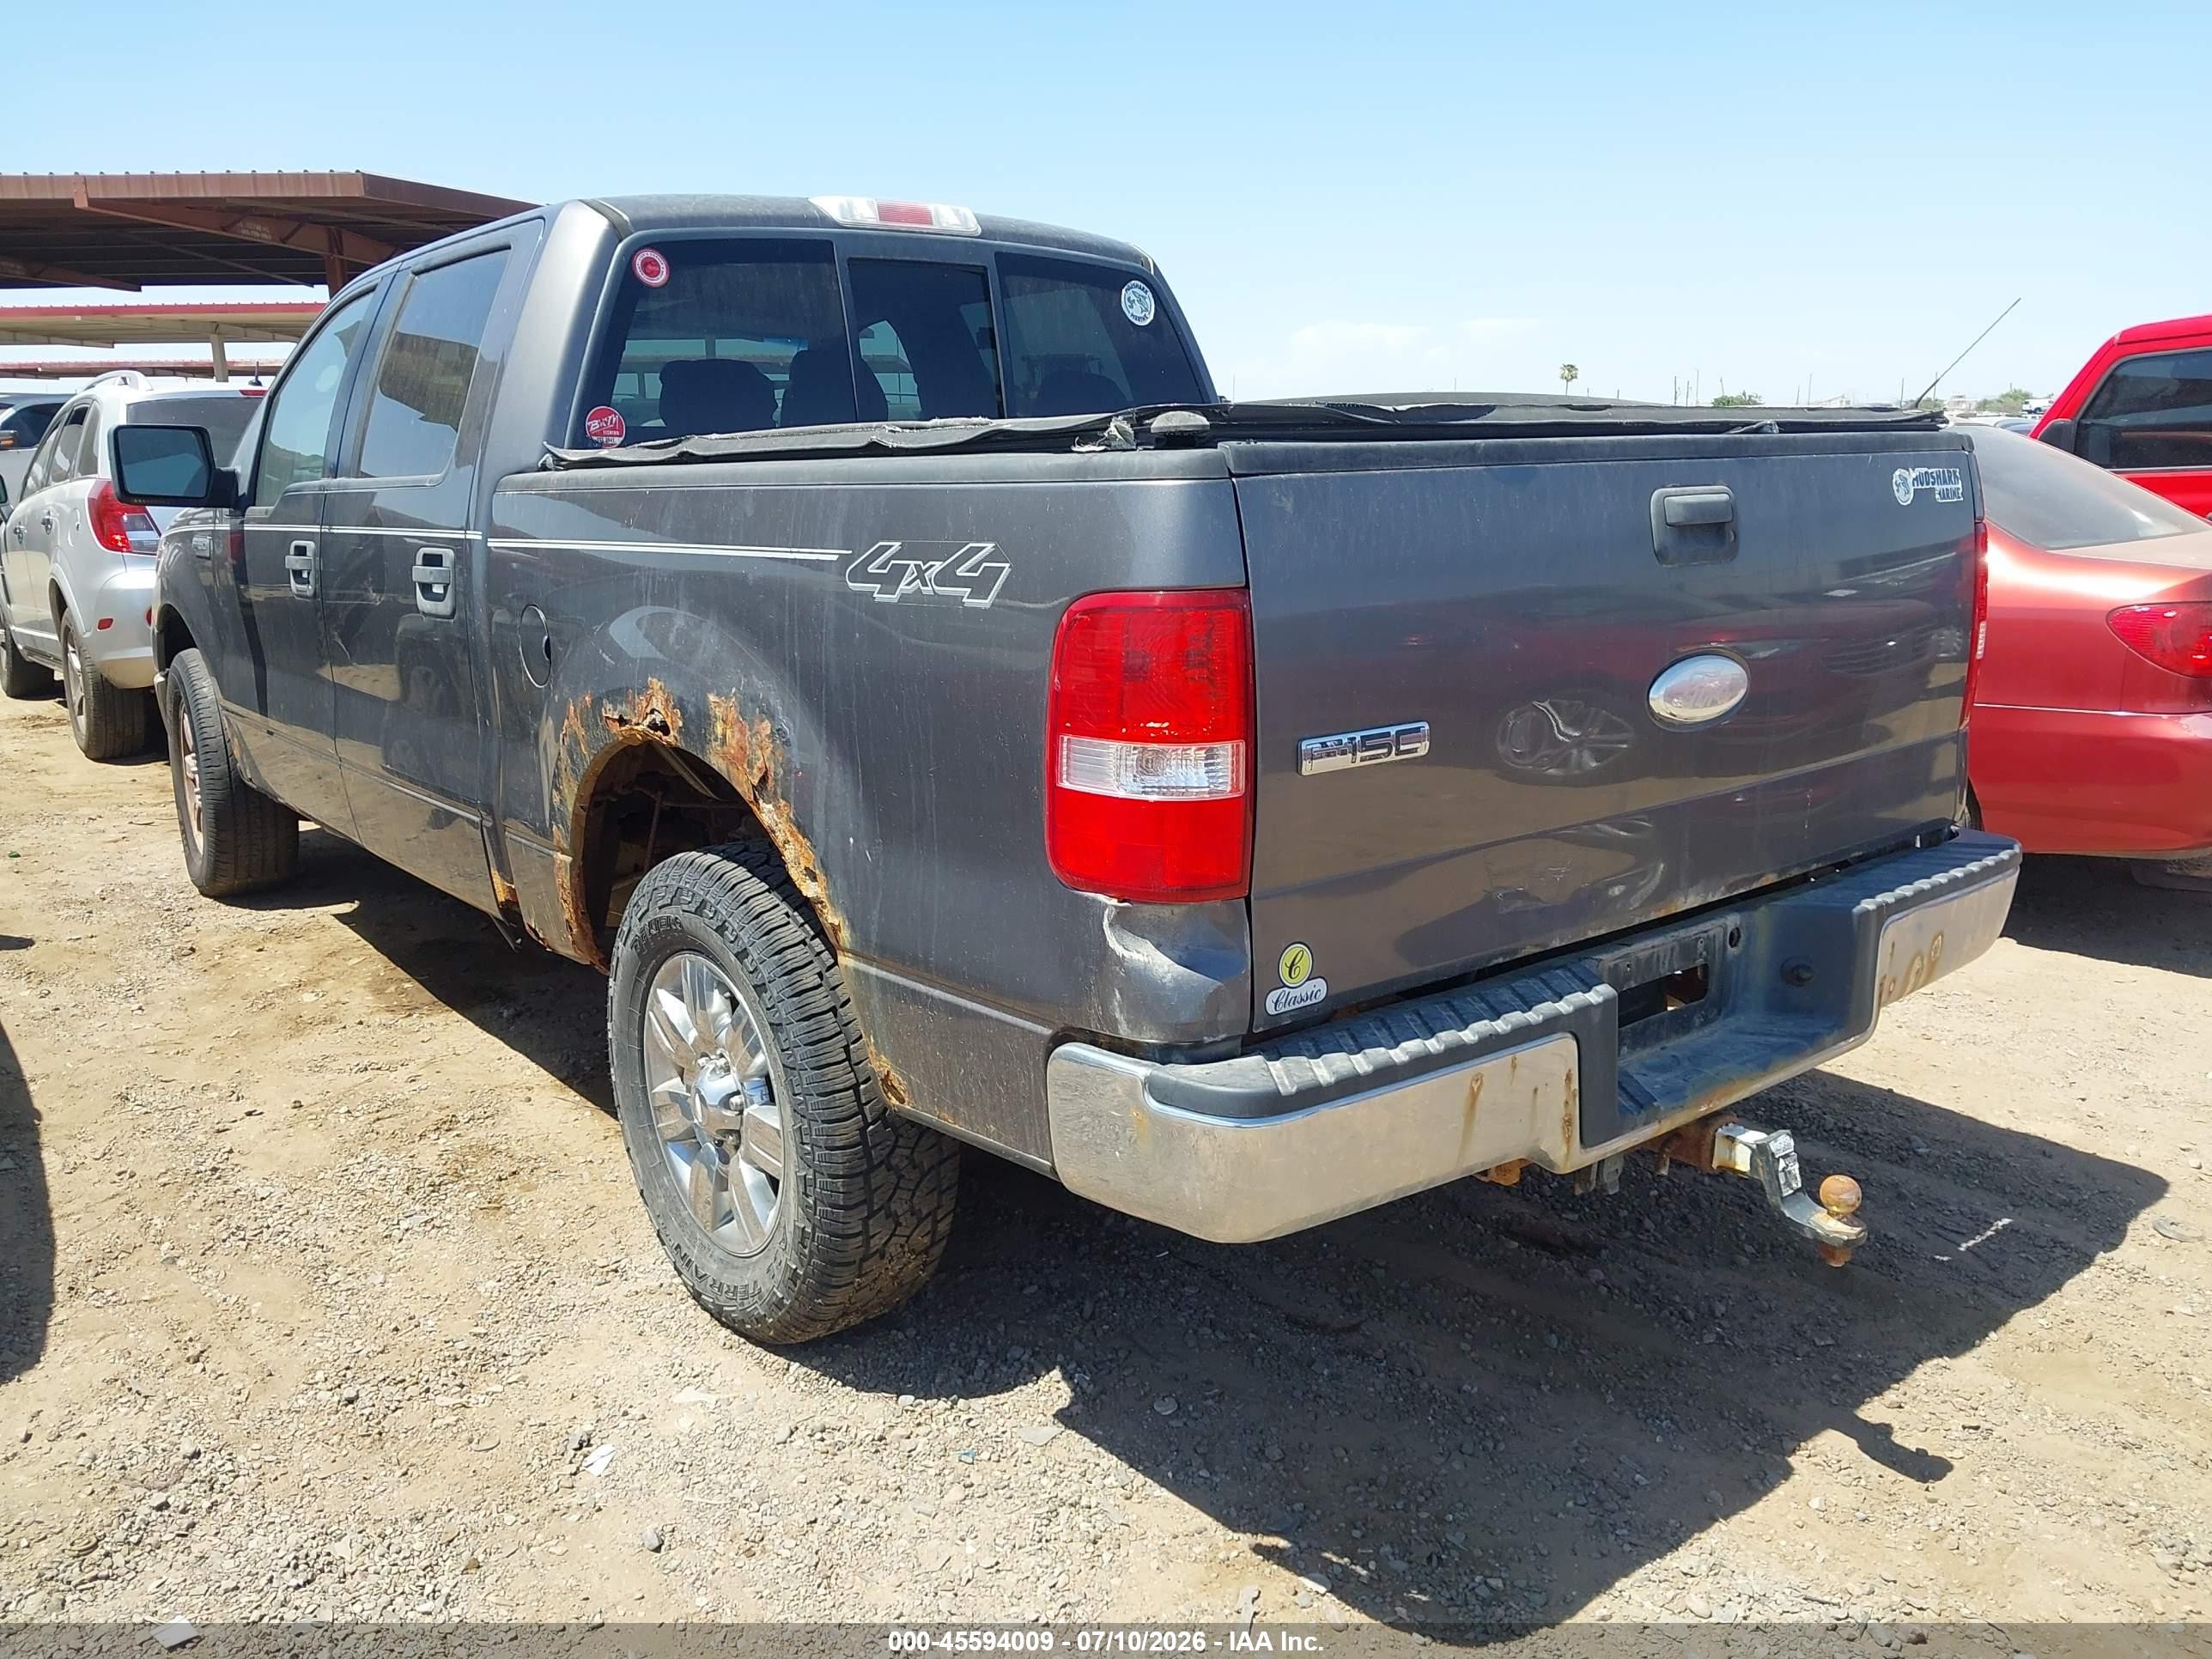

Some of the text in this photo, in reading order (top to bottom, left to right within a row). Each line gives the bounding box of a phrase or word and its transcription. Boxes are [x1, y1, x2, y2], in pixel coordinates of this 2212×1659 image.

[1912, 469, 1960, 487] MUDSHARK
[1304, 725, 1429, 771] F-150
[1285, 949, 1304, 980] C
[1272, 984, 1322, 1012] Classic
[672, 1243, 763, 1301] TERRAIN
